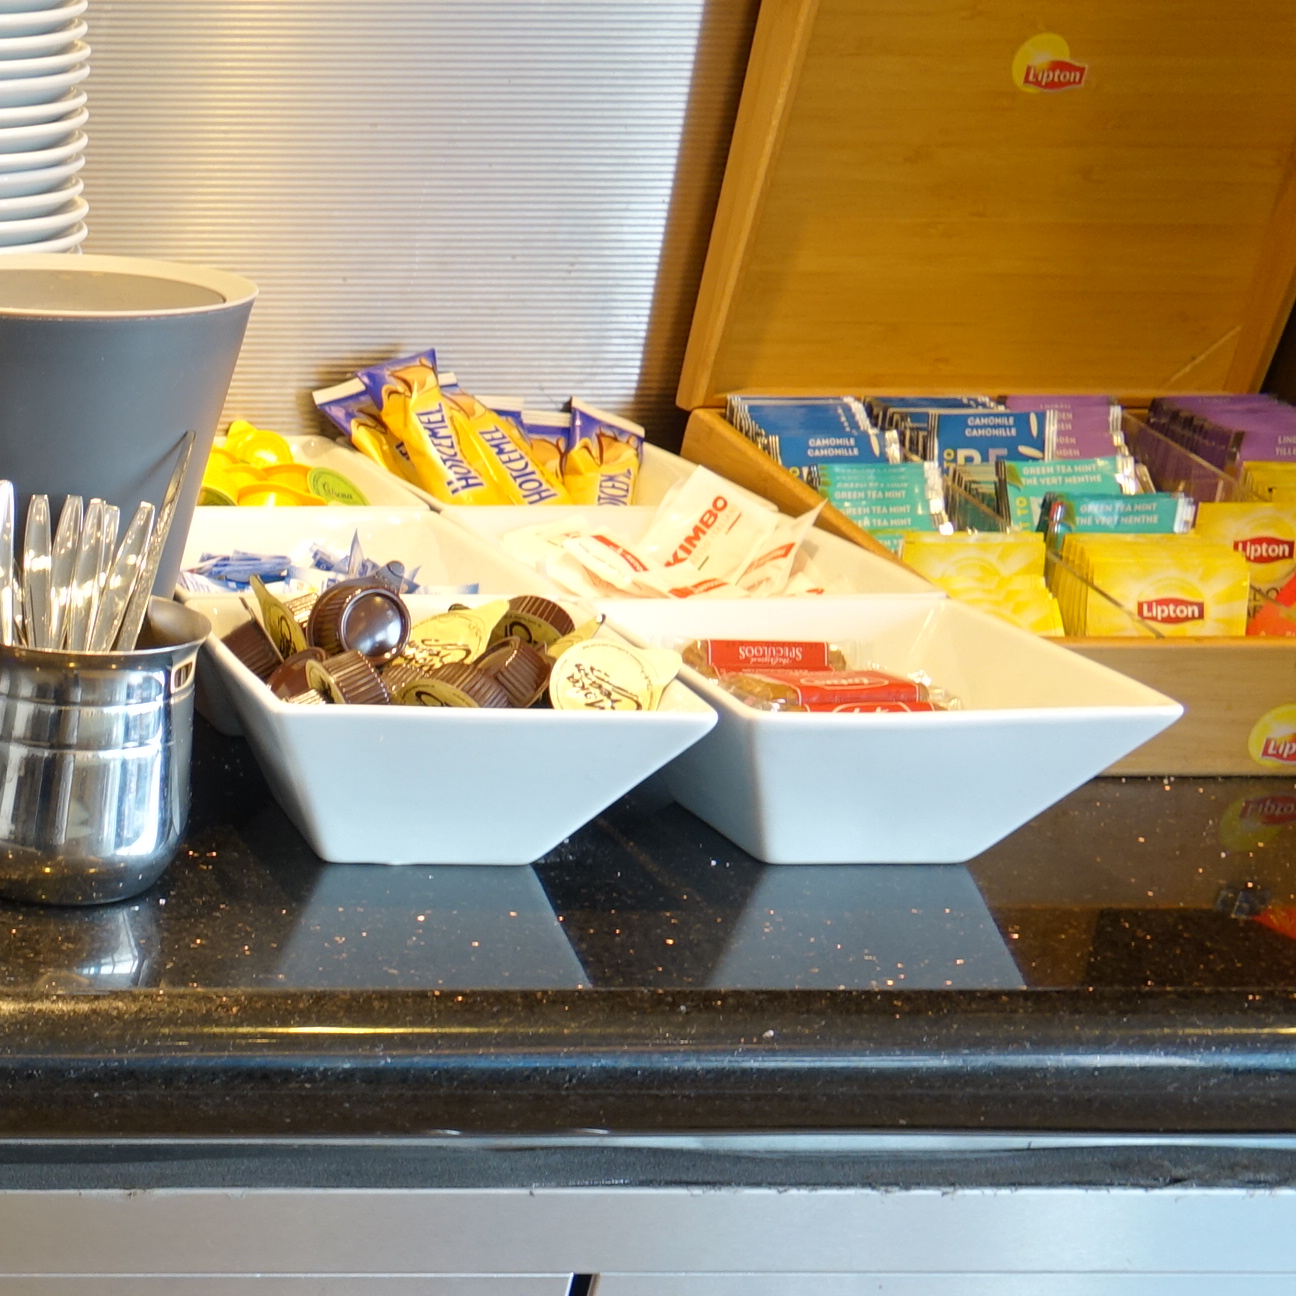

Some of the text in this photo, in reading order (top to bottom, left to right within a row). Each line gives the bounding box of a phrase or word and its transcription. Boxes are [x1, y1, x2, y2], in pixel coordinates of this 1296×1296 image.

[1029, 67, 1080, 85] Lipton
[967, 416, 1014, 426] CAMOMILE
[965, 428, 1016, 437] CAMOMILLE
[809, 438, 855, 447] CAMOMILE
[807, 448, 859, 457] CAMOMILLE
[1023, 463, 1096, 475] GREEN TEA MINT
[1040, 475, 1065, 485] VERT
[835, 490, 906, 499] GREEN TEA MINT
[1080, 503, 1116, 514] GREEN
[1119, 503, 1137, 513] TEA
[1121, 513, 1158, 524] MENTHE
[664, 495, 728, 567] KIMBO
[1238, 541, 1289, 559] Lipton
[1142, 601, 1199, 619] Lipton
